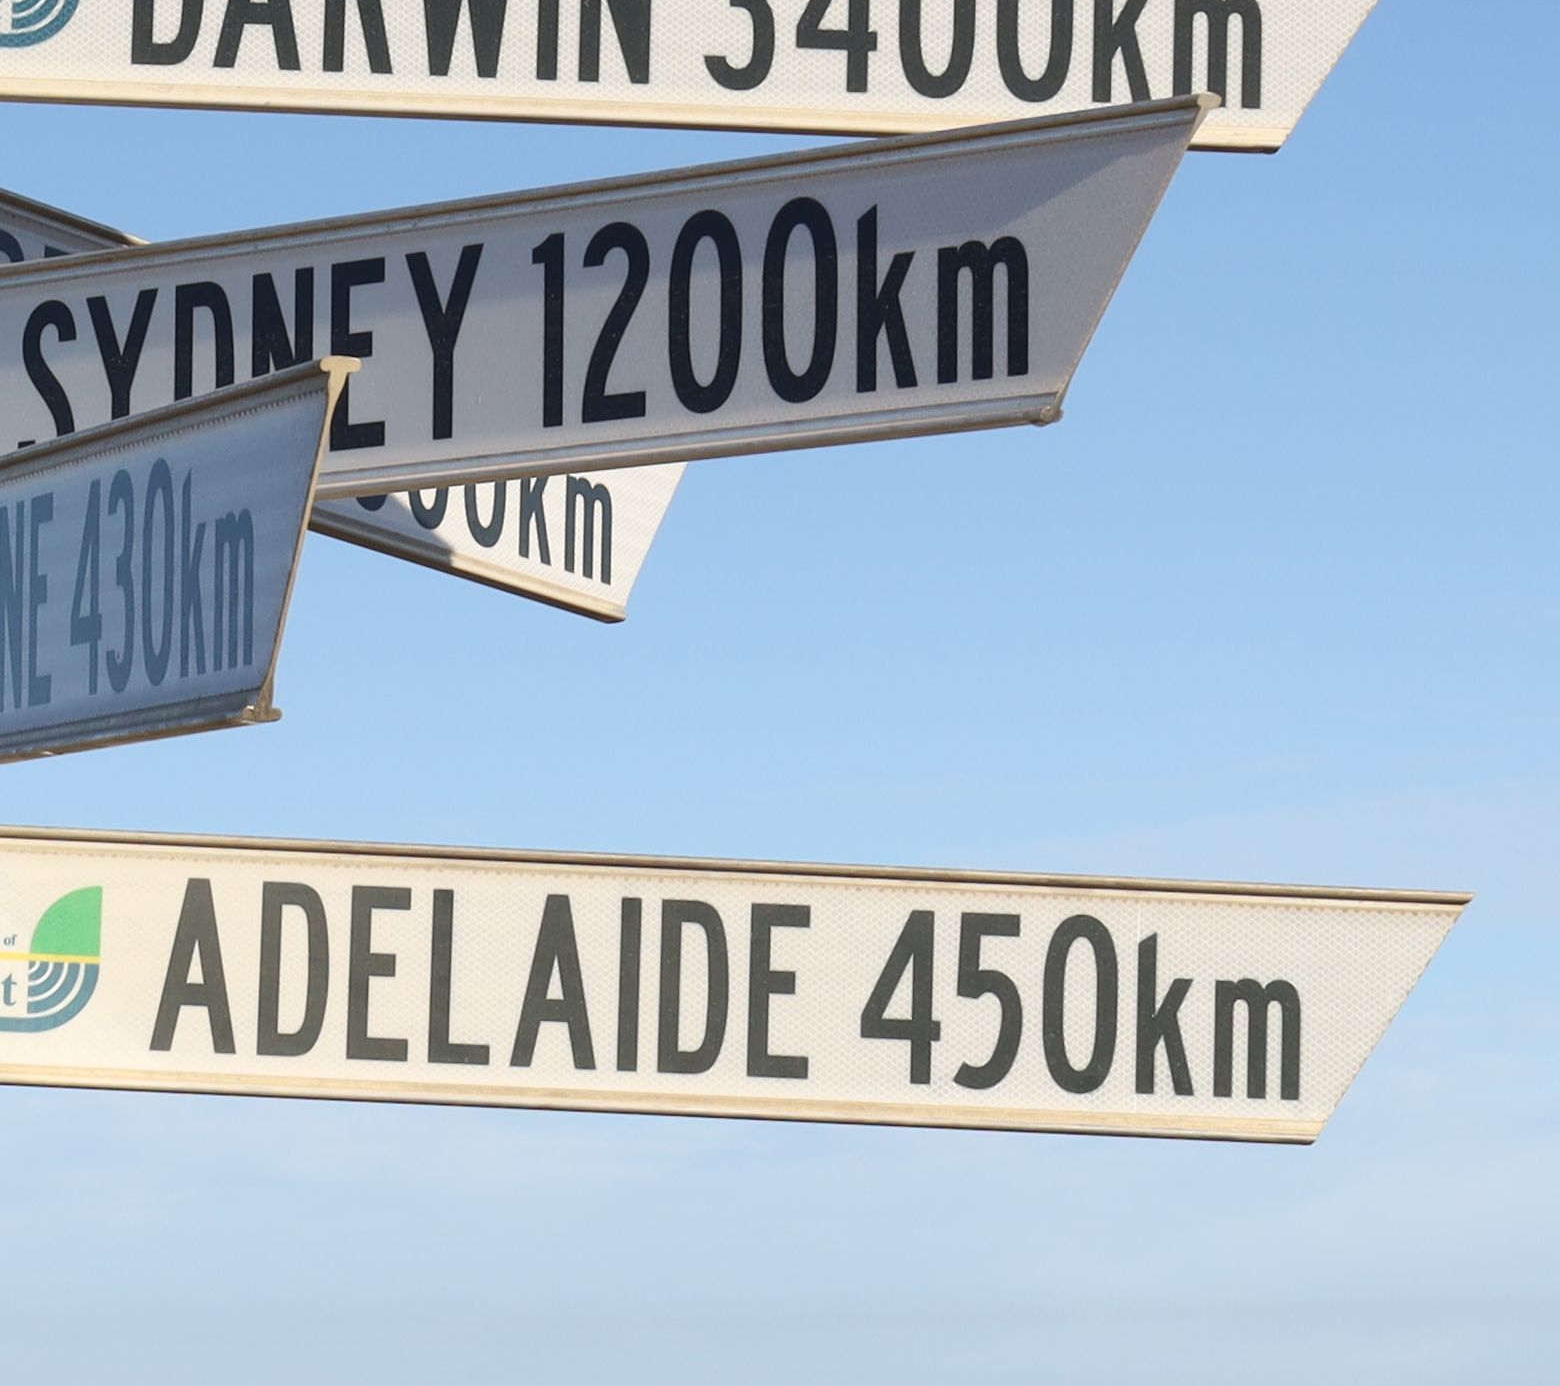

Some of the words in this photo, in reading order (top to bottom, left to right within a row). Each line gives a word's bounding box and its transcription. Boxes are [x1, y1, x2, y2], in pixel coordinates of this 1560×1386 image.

[18, 243, 484, 452] SYDNEY
[532, 196, 1029, 428] 1200km
[70, 457, 254, 696] 430km
[3, 934, 18, 946] of
[149, 878, 811, 1080] ADELAIDE
[860, 910, 1301, 1101] 450km
